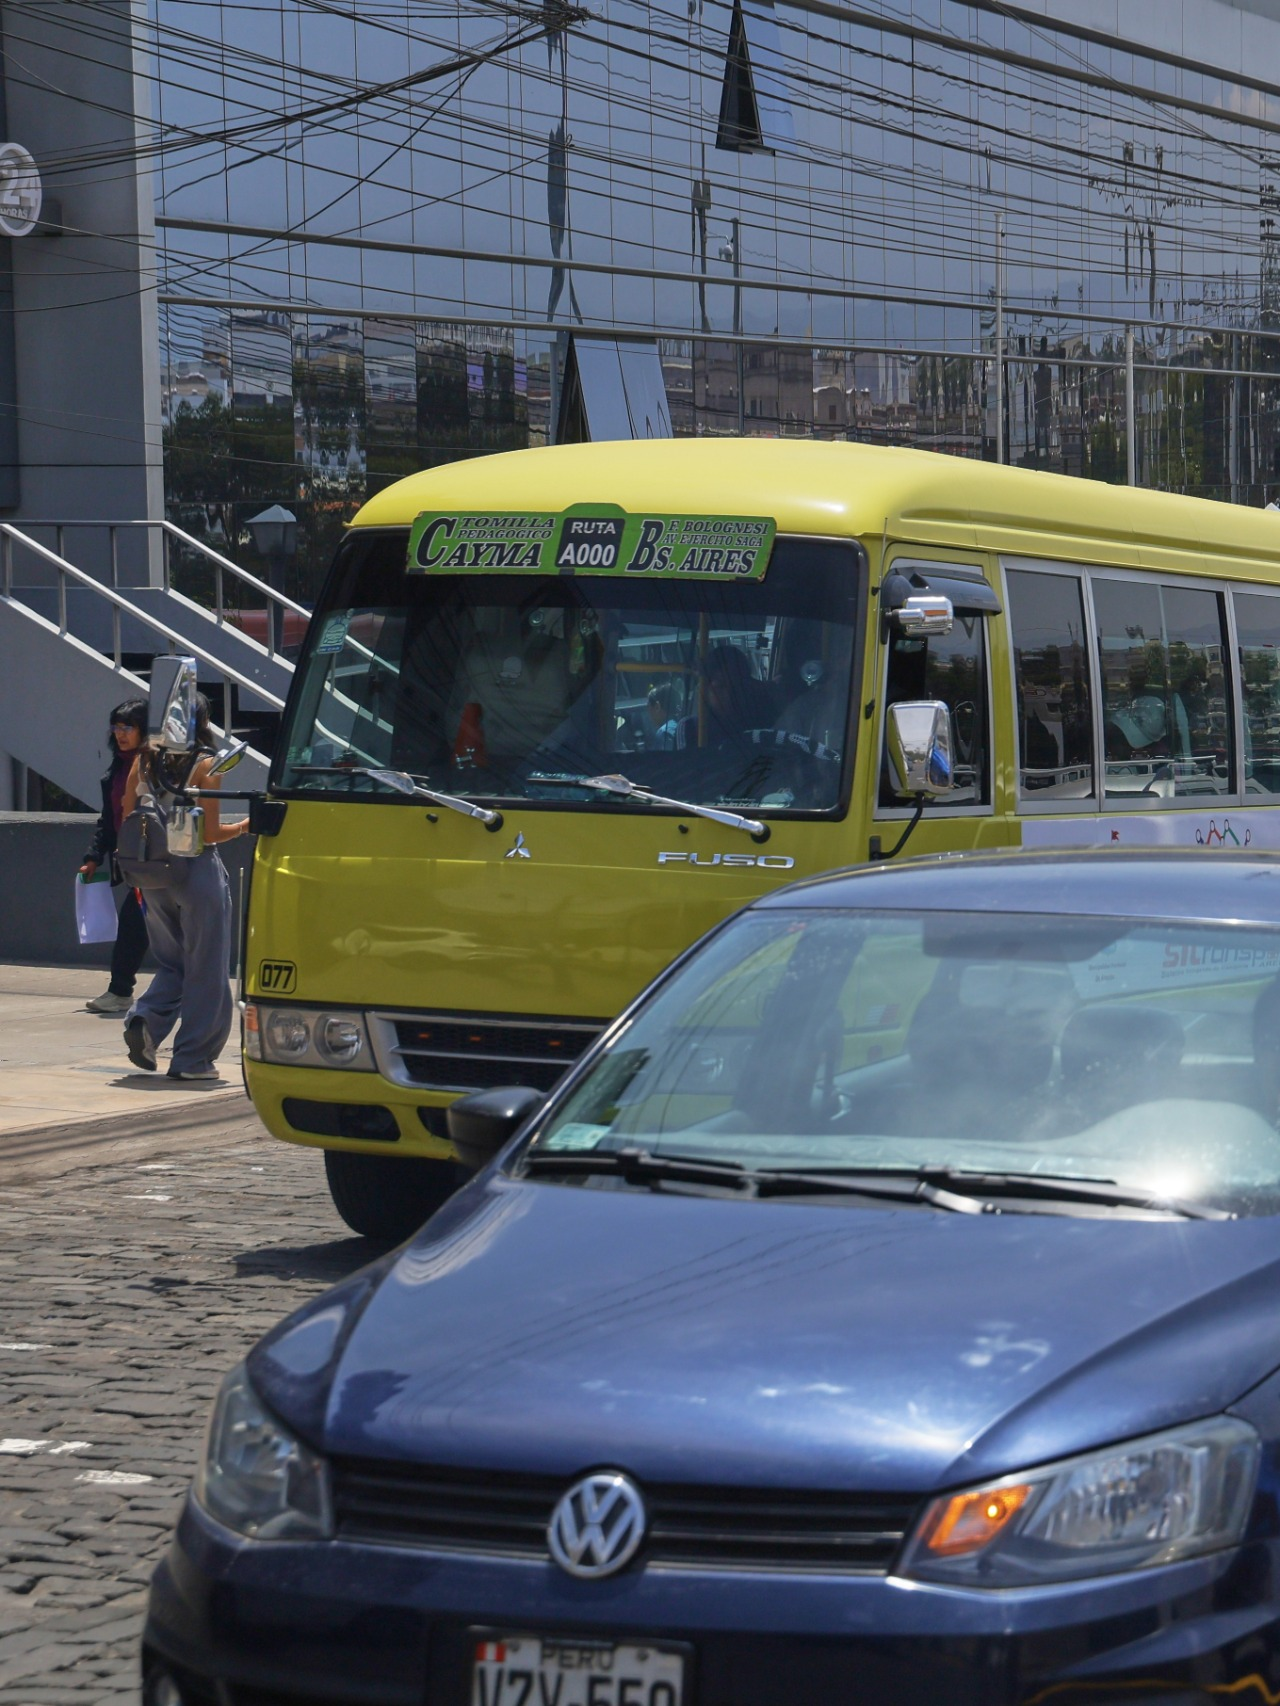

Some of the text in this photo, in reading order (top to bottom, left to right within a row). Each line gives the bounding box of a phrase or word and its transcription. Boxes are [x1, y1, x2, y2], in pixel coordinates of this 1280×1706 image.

[461, 516, 556, 529] TOMILLA
[571, 521, 616, 534] RUTA
[666, 520, 769, 535] F. BOLOGNESI
[416, 516, 543, 568] CAYMA
[456, 529, 553, 540] PEDAGOGICO
[679, 533, 734, 546] EJERCITO
[735, 536, 763, 547] SAGA
[558, 542, 615, 566] A000
[677, 547, 757, 575] AIRES
[658, 852, 795, 869] FUSO
[261, 964, 294, 989] 077
[541, 1649, 614, 1670] PERU
